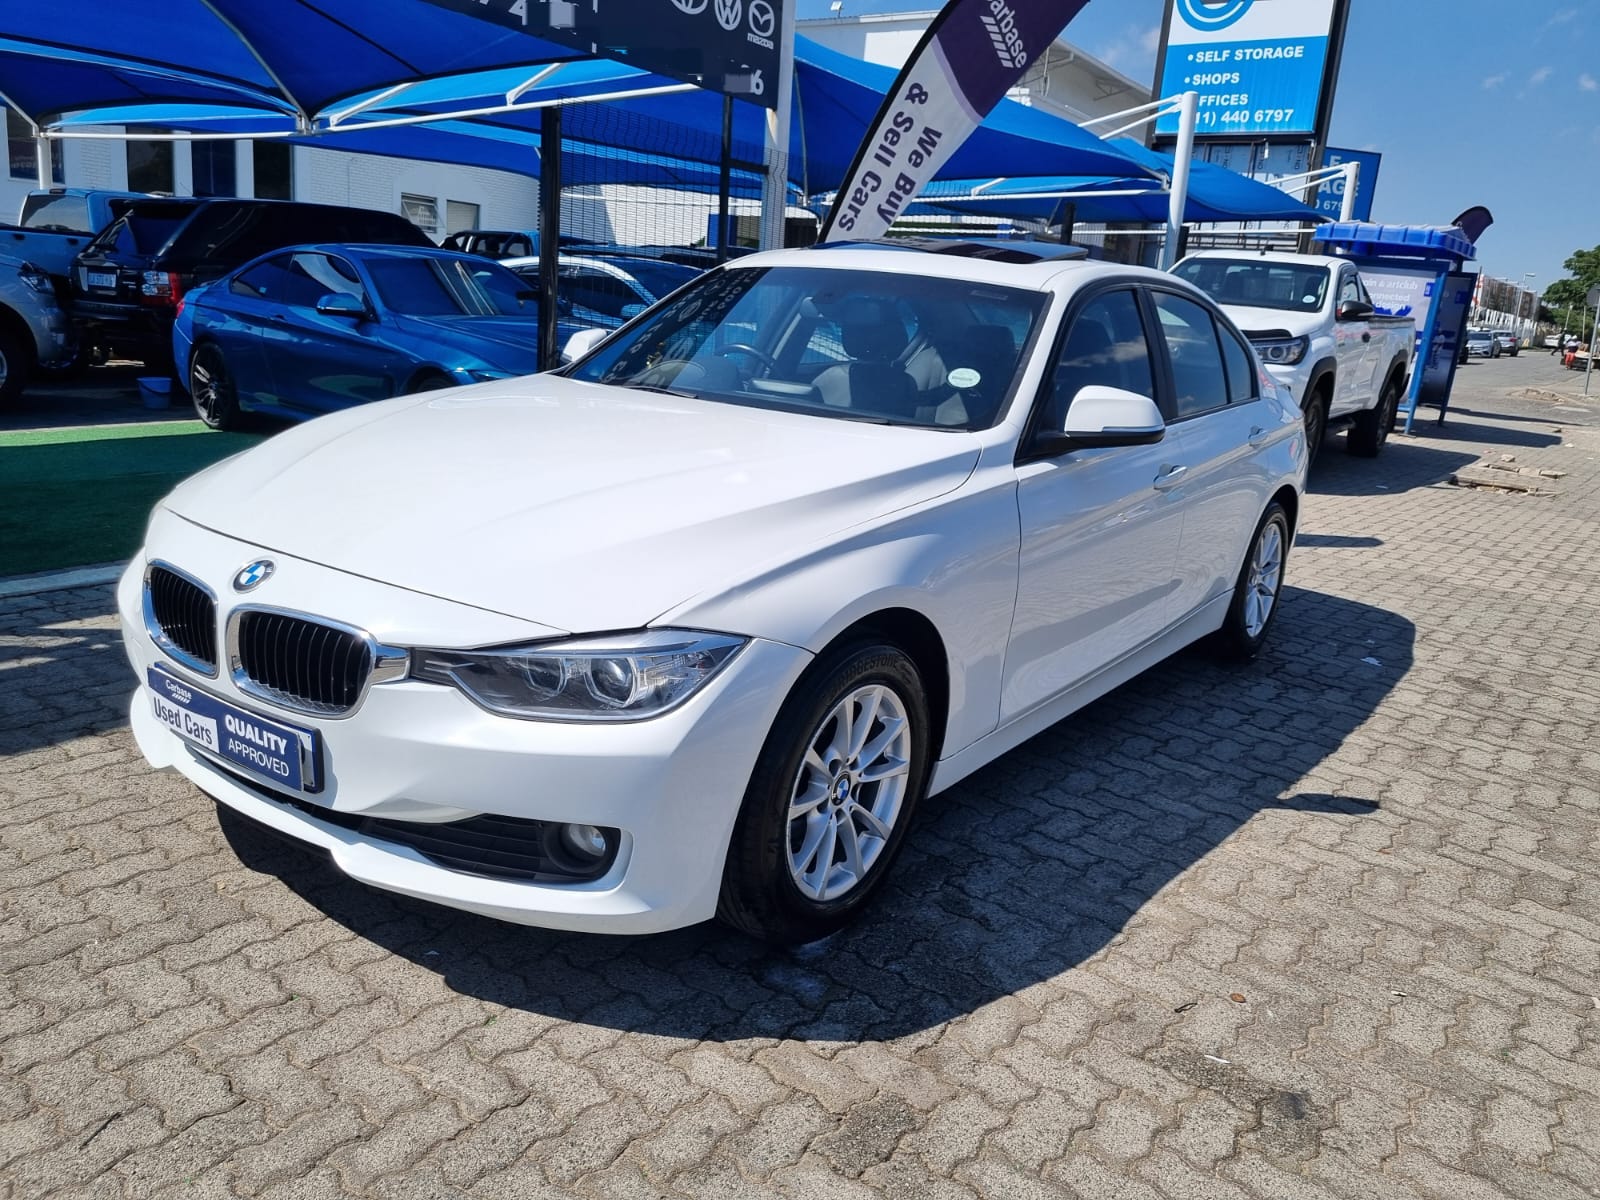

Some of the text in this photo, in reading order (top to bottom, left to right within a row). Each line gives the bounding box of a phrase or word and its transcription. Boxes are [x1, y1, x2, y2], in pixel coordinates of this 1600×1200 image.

[747, 32, 774, 50] mazda
[990, 0, 1027, 69] arbase
[1195, 45, 1305, 63] SELF STORAGE
[1192, 72, 1240, 86] SHOPS
[1199, 94, 1249, 106] FFICES
[1195, 108, 1294, 127] 11) 440 6797
[838, 82, 929, 232] & Sell Cars
[877, 125, 943, 225] We Buy
[1369, 293, 1410, 302] onnected
[165, 679, 192, 699] Carbase
[153, 696, 213, 745] Used Cars
[225, 714, 288, 755] QUALITY
[228, 737, 290, 777] APPROVED
